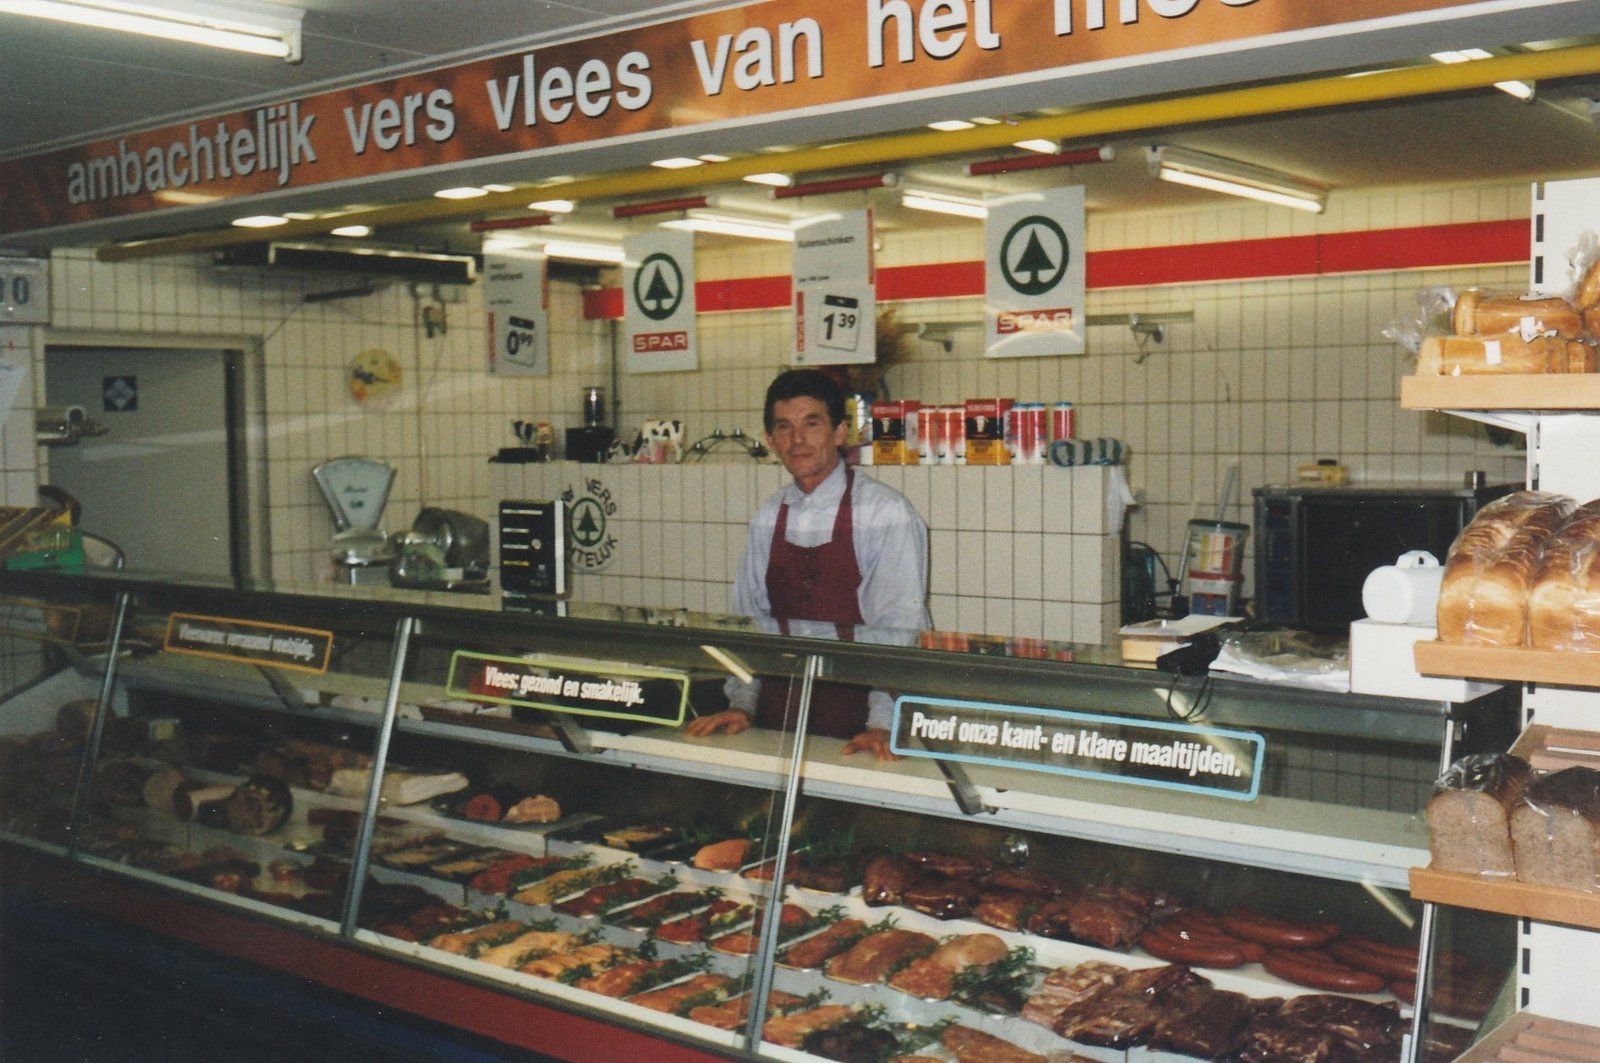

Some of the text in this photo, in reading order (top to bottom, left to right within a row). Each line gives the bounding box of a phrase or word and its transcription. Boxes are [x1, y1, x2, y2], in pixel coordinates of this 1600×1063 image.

[67, 101, 317, 204] ambachtelijk
[343, 88, 456, 155] vers
[486, 50, 653, 131] vlees
[691, 17, 823, 96] van
[866, 0, 1001, 67] het
[998, 311, 1071, 330] SPAR
[634, 334, 687, 351] SPAR
[584, 477, 617, 516] VERS
[485, 666, 645, 707] Vlees: gezond en smakelijk.
[910, 711, 1242, 777] Proef onze kant- en klare maaltijden.
